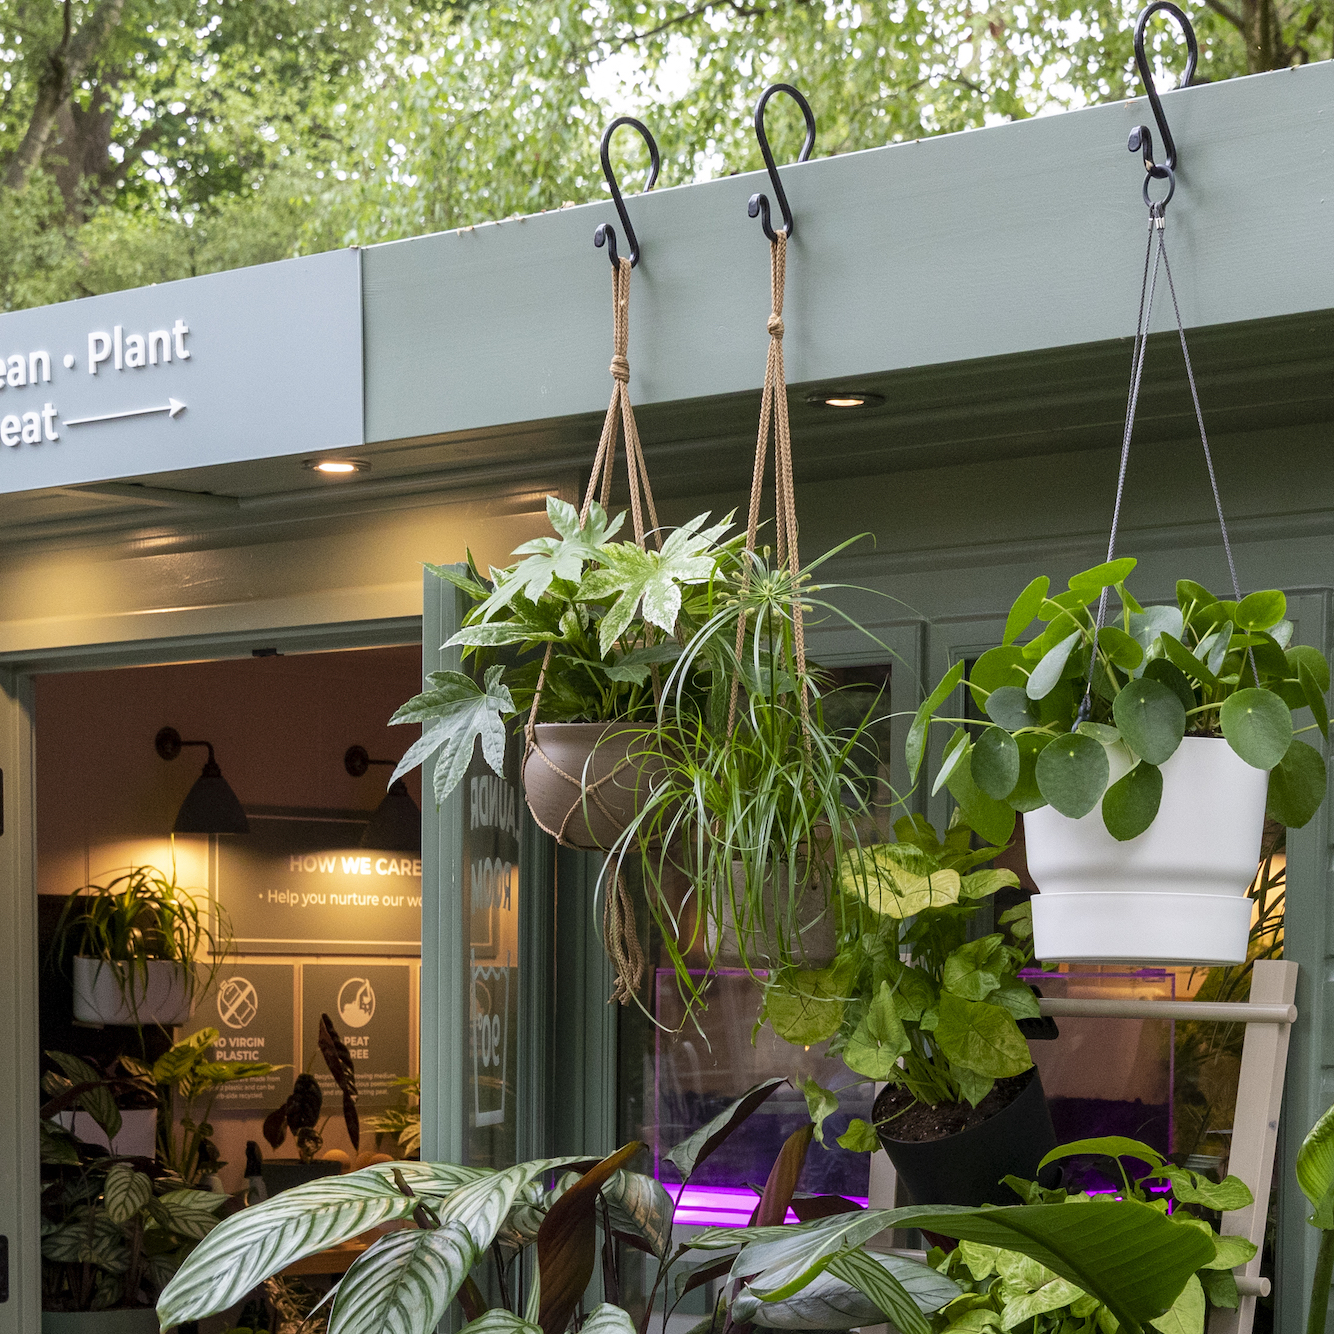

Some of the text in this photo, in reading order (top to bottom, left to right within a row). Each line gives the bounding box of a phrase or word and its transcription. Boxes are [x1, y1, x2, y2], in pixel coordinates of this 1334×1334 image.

[88, 319, 191, 375] Plant
[290, 855, 422, 877] HOW WE CARE
[268, 889, 299, 907] Help
[301, 892, 326, 907] you
[329, 891, 380, 906] nurture
[382, 894, 405, 907] our
[229, 1037, 265, 1048] VIRGIN
[343, 1036, 369, 1046] PEAT
[216, 1050, 259, 1061] PLASTIC
[349, 1049, 369, 1059] REE
